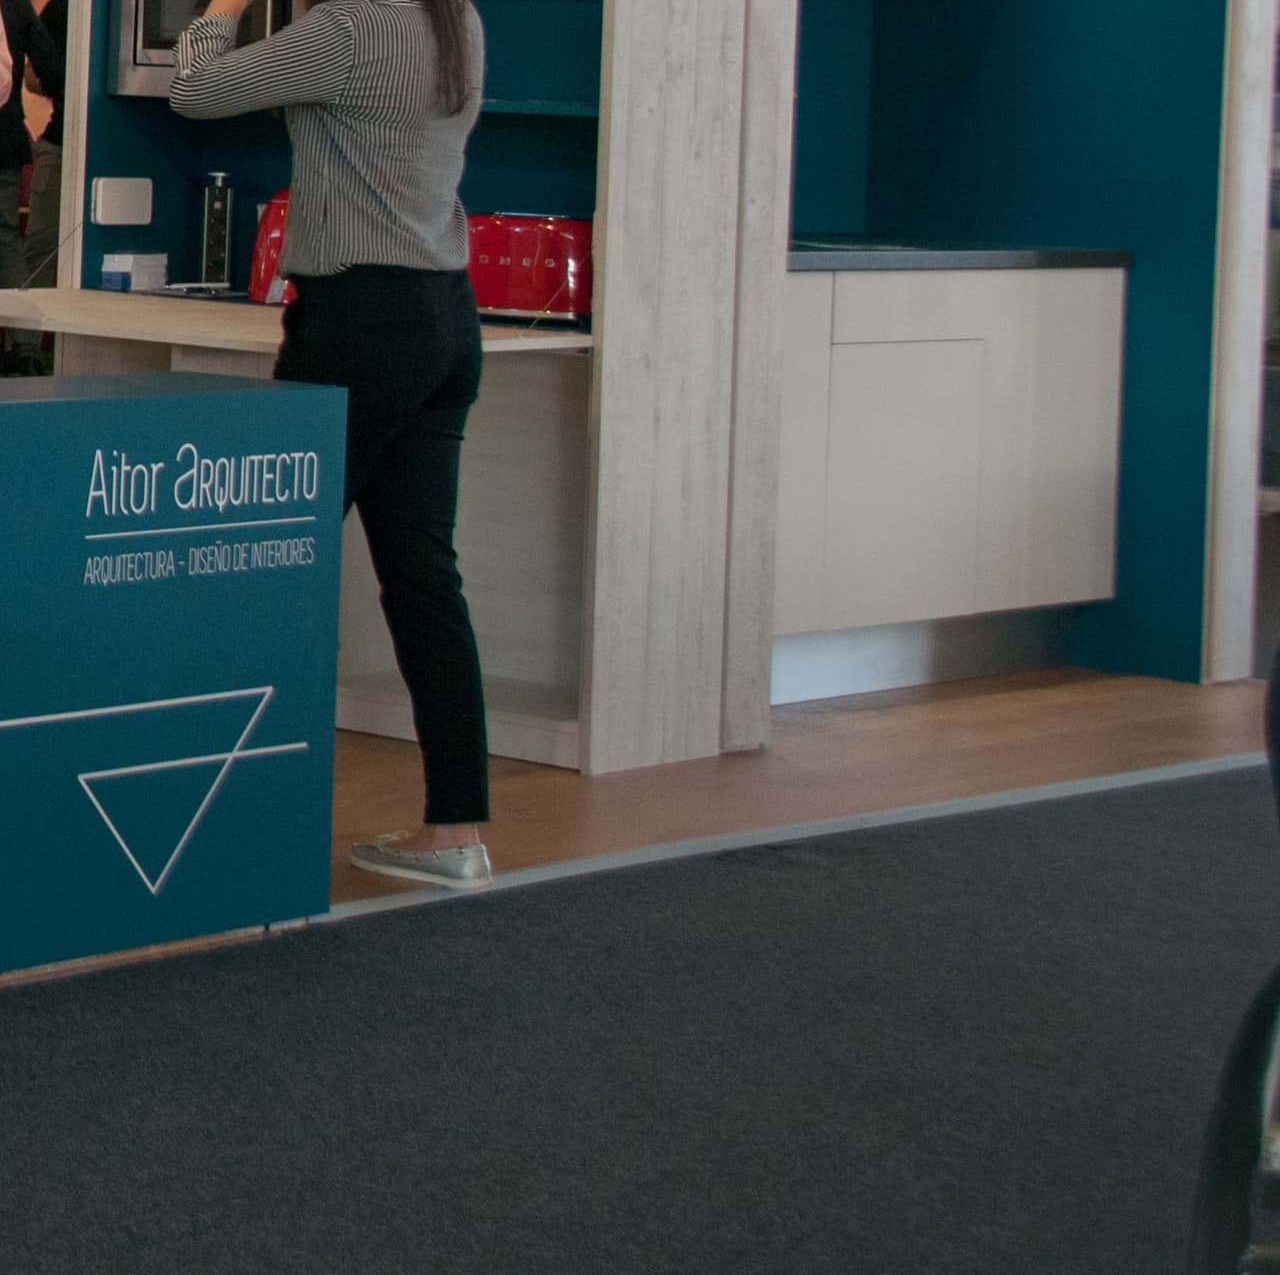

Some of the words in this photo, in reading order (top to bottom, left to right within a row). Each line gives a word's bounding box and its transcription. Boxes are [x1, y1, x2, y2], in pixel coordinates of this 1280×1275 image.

[86, 449, 164, 517] Aitor
[84, 550, 175, 586] ARQUITECTURA
[189, 540, 230, 576] DISEÑO
[233, 542, 248, 571] DE
[251, 537, 315, 569] INTERIORES
